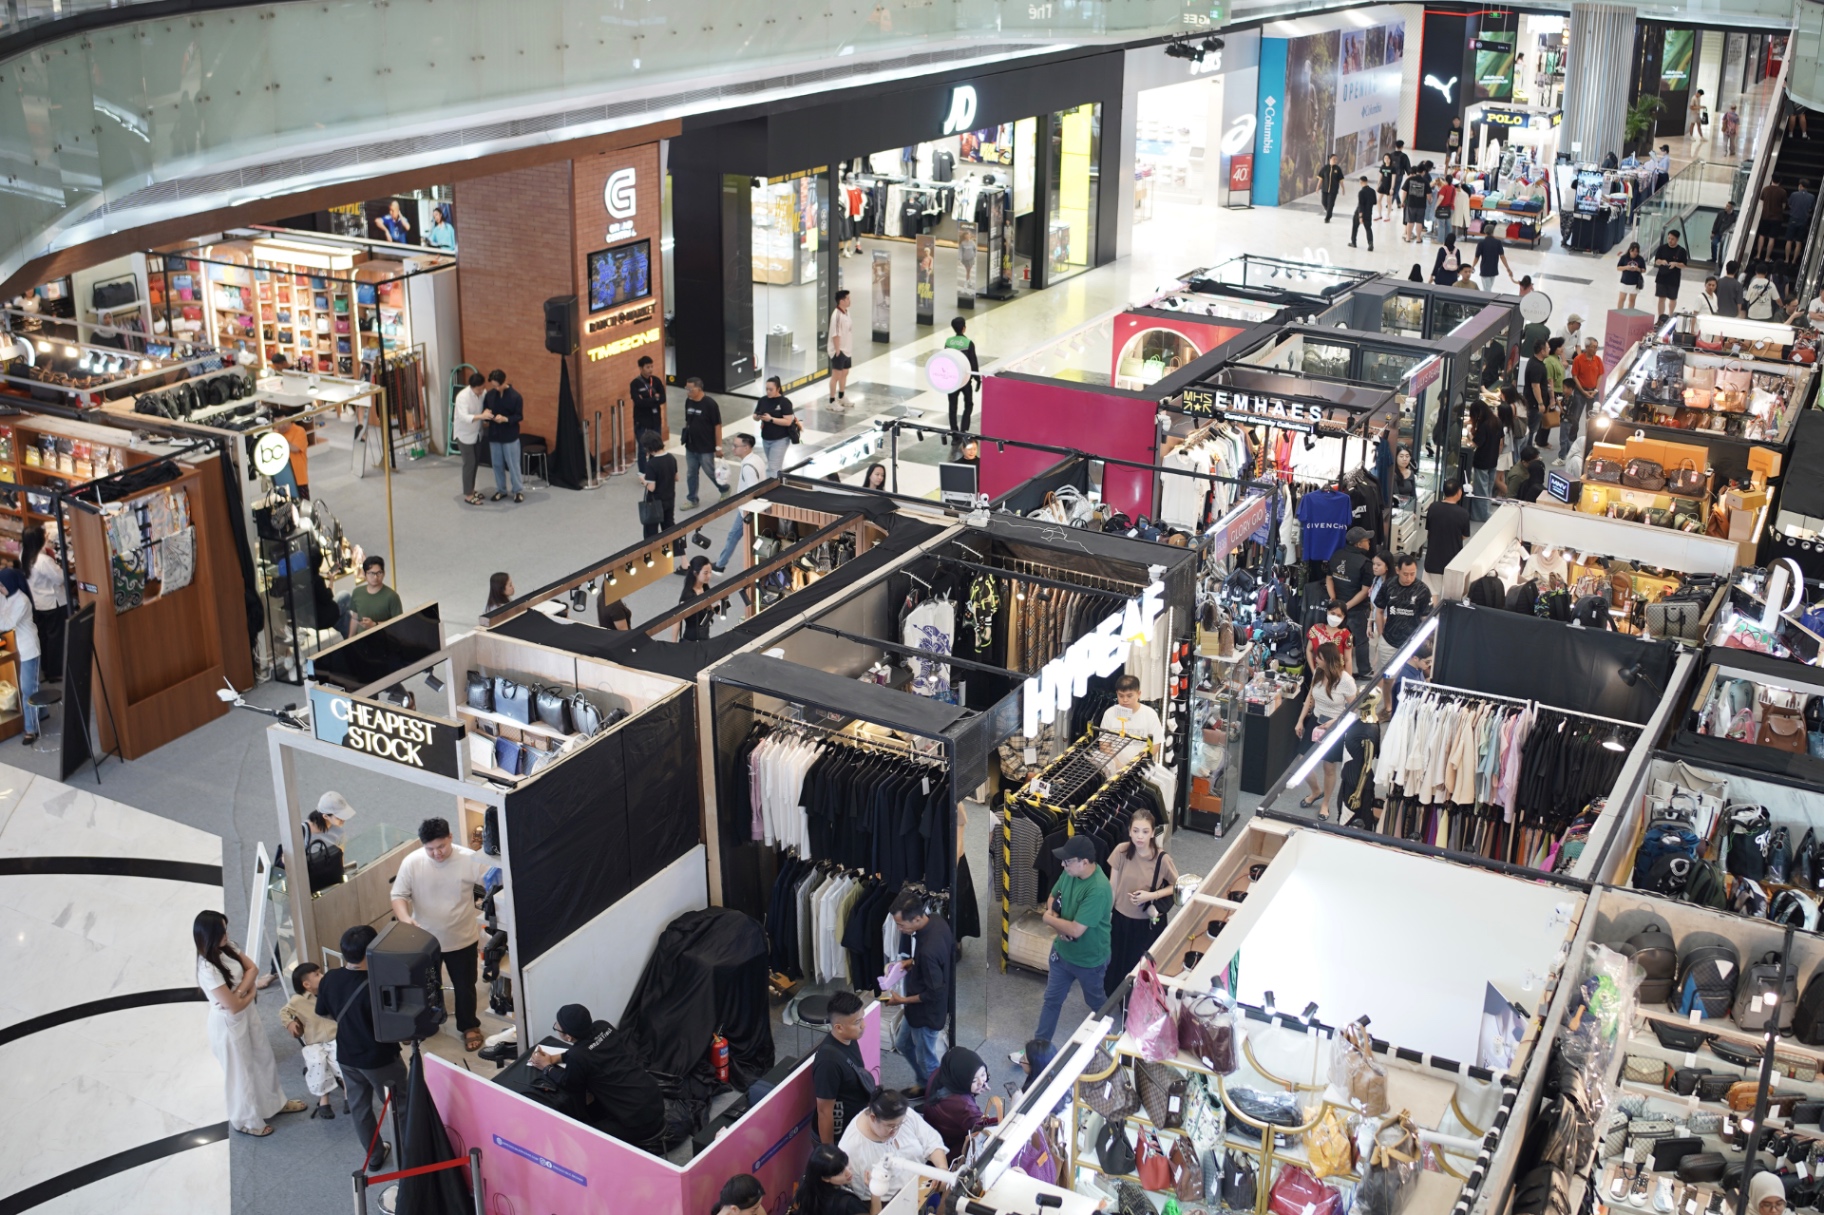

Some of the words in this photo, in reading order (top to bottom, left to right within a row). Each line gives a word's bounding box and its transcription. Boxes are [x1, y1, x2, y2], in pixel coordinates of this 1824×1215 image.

[943, 85, 977, 135] JD
[1486, 113, 1523, 125] POLO
[1263, 106, 1276, 154] Columbia
[587, 328, 660, 362] TIMEZONE
[1215, 391, 1322, 422] EMHAES
[1230, 519, 1251, 543] GLORY
[1251, 509, 1263, 526] GIO
[1306, 522, 1348, 531] GIVENCHY
[330, 698, 437, 745] CHEAPEST
[348, 726, 424, 767] STOCK
